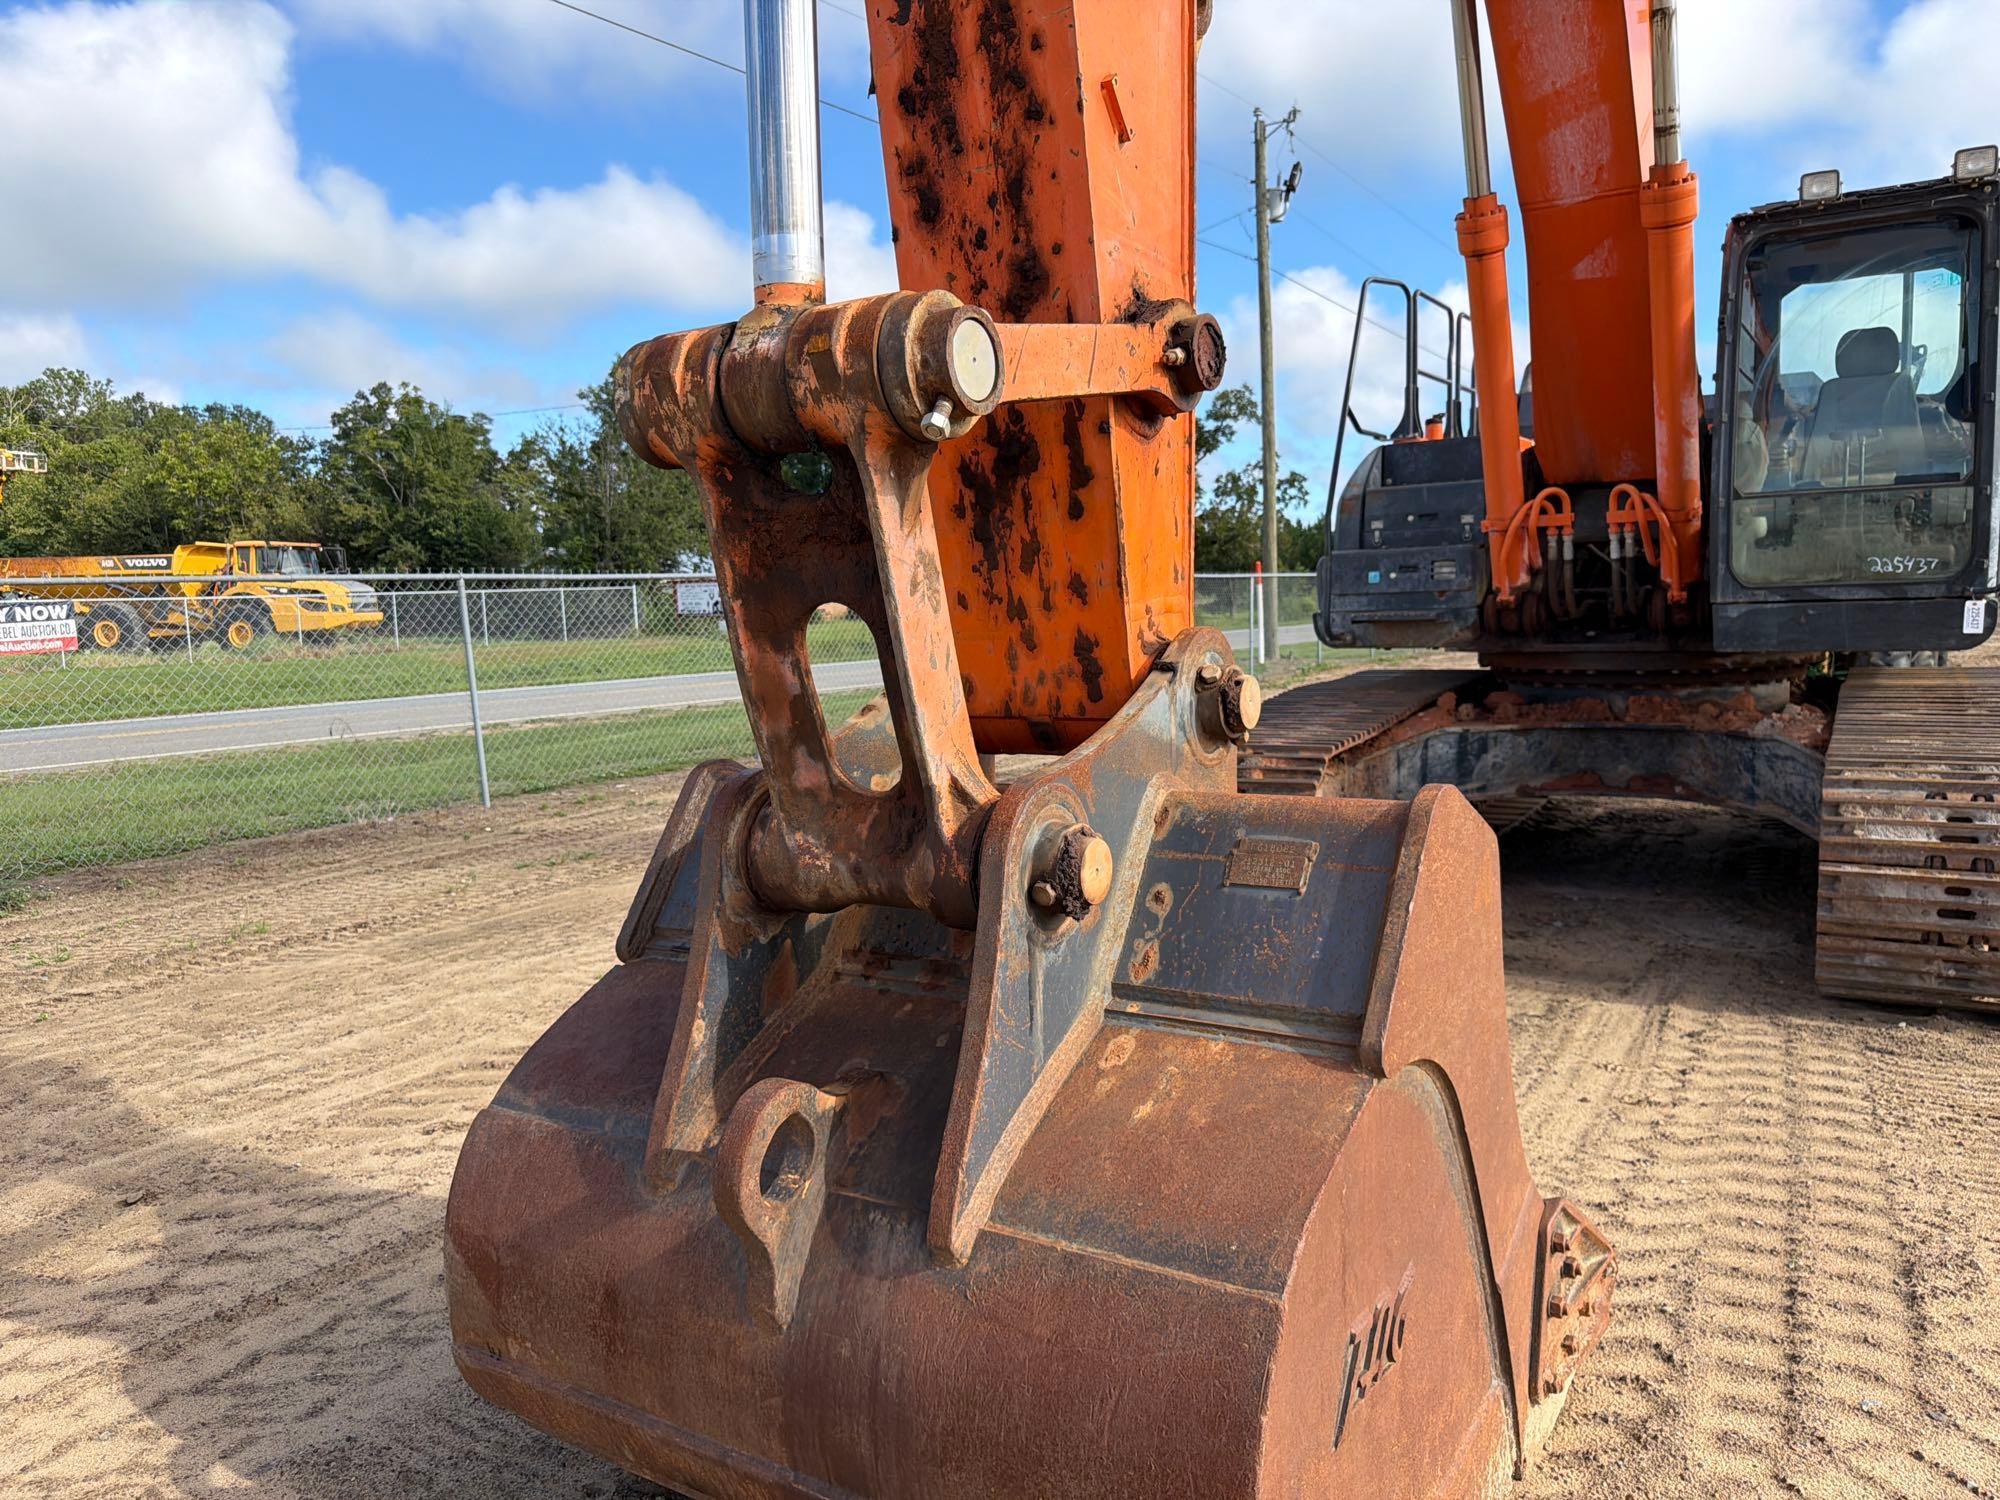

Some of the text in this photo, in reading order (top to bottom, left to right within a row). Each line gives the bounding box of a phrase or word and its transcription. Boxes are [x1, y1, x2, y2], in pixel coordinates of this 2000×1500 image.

[125, 558, 168, 567] VOLVO
[1867, 555, 1939, 574] 225437
[14, 604, 68, 621] NOW
[0, 626, 18, 639] BEL
[21, 624, 57, 638] AUCTION
